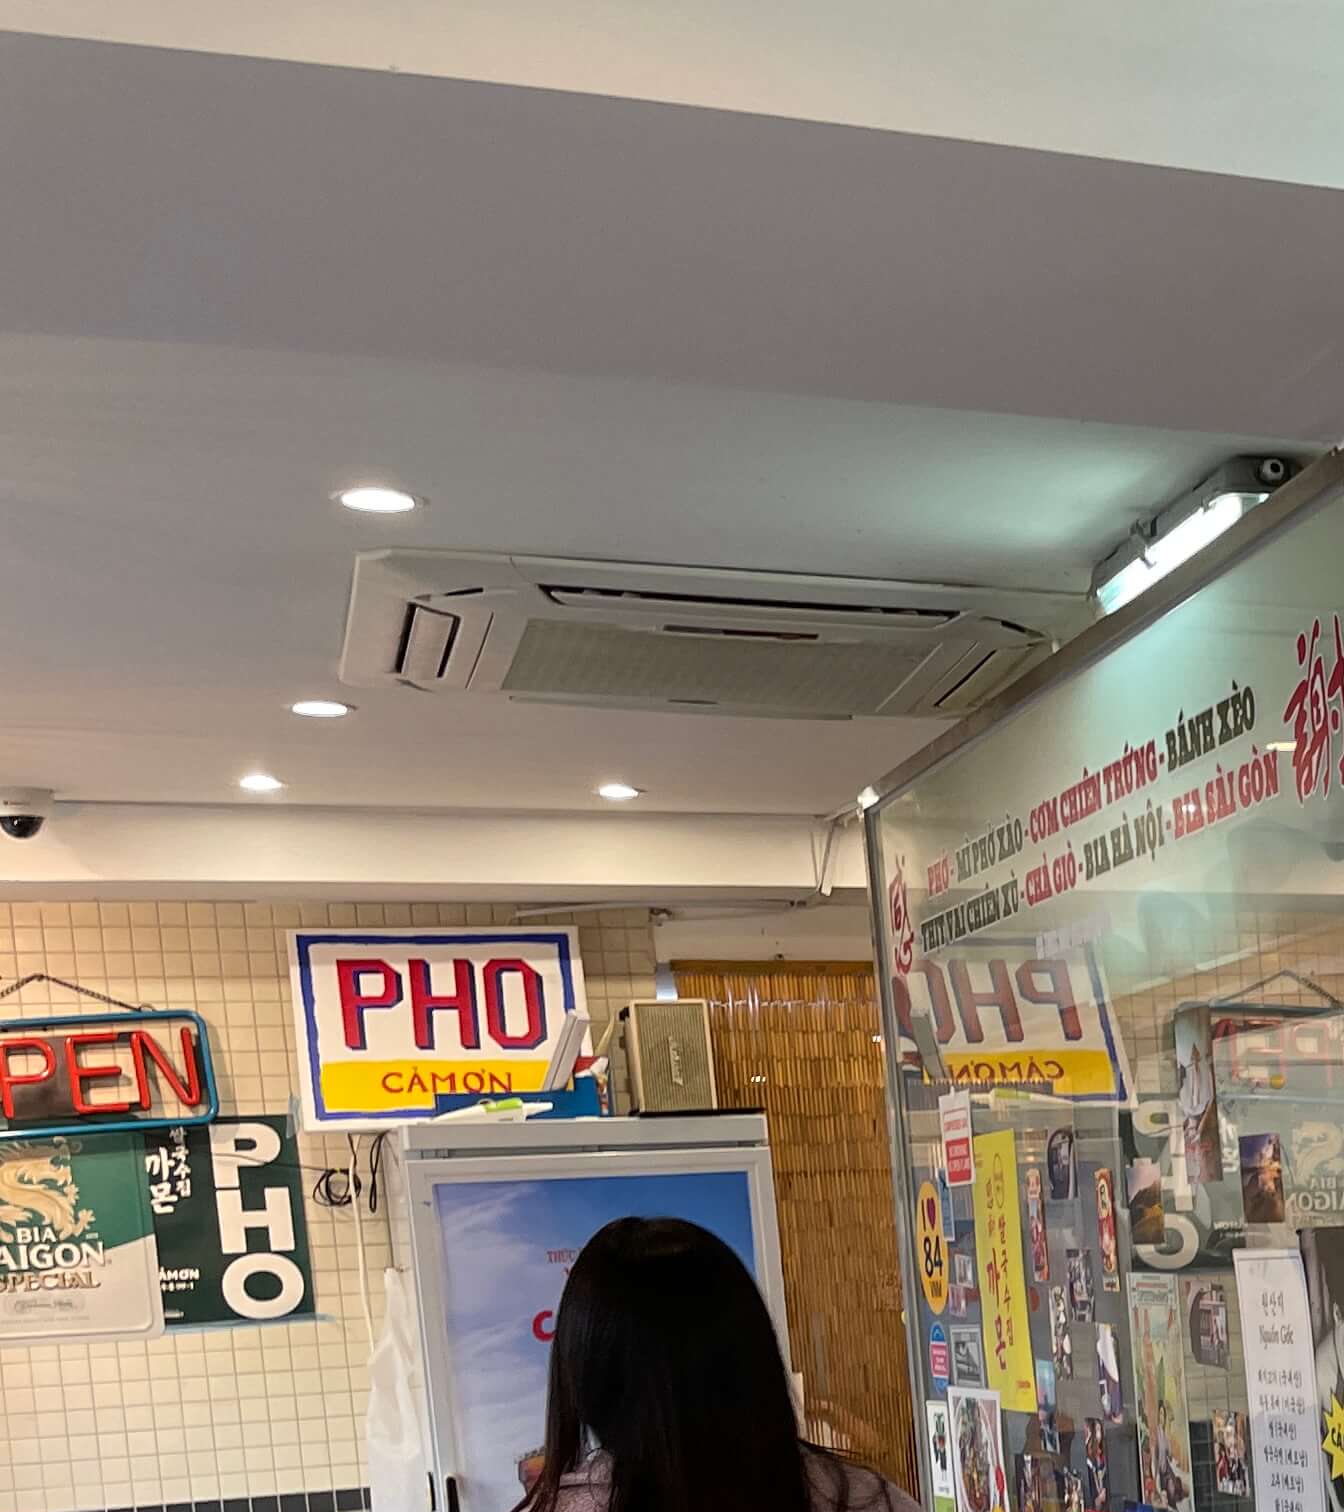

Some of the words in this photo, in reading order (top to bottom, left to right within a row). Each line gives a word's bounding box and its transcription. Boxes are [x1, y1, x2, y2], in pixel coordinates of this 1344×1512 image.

[1030, 797, 1059, 844] CƠM
[1060, 767, 1101, 828] CHIÊN
[1103, 741, 1158, 805] TRỨNG
[1165, 708, 1216, 773] BÁNH
[1217, 679, 1255, 745] XÈO
[1083, 835, 1110, 882] BIA
[1111, 811, 1133, 867] HÀ
[1135, 799, 1164, 863] NỘI
[1172, 788, 1204, 841] BIA
[1206, 764, 1237, 825] SÀI
[1238, 745, 1279, 809] GÒN
[336, 958, 549, 1051] PHO
[381, 1065, 513, 1094] CẢMƠN
[145, 1147, 179, 1214] 까몬
[15, 1227, 57, 1245] BIA
[208, 1122, 306, 1320] PHO
[923, 1235, 943, 1278] 84
